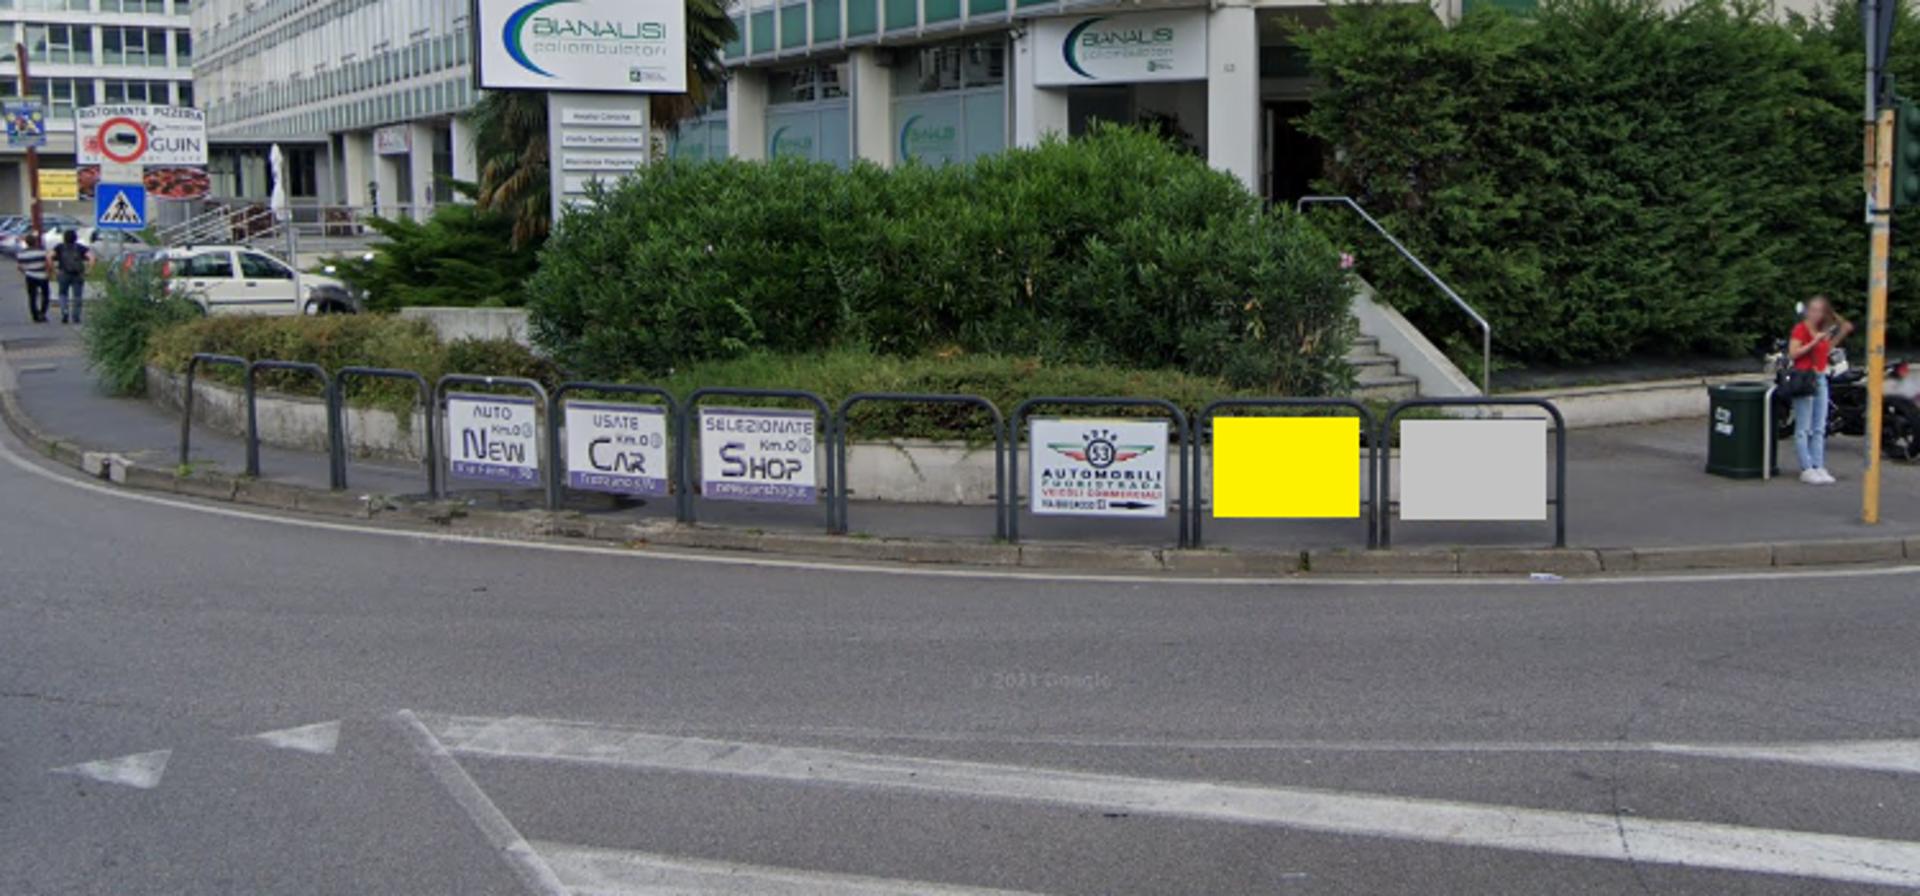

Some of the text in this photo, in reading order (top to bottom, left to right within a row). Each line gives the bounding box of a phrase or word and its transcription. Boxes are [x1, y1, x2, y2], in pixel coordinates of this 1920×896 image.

[533, 17, 667, 39] BIANALISI
[1082, 27, 1174, 47] BIANALISI
[80, 106, 203, 121] RISTORANTE PIZZERIA
[473, 405, 513, 420] AUTO
[593, 414, 639, 430] USATE
[705, 416, 813, 435] SELEZIONATE
[1092, 445, 1110, 462] 53
[1042, 468, 1161, 481] AUTOMOBILI
[1042, 480, 1162, 490] FUORISTRADA
[1042, 488, 1162, 500] VEICOLI COMMERCIALI
